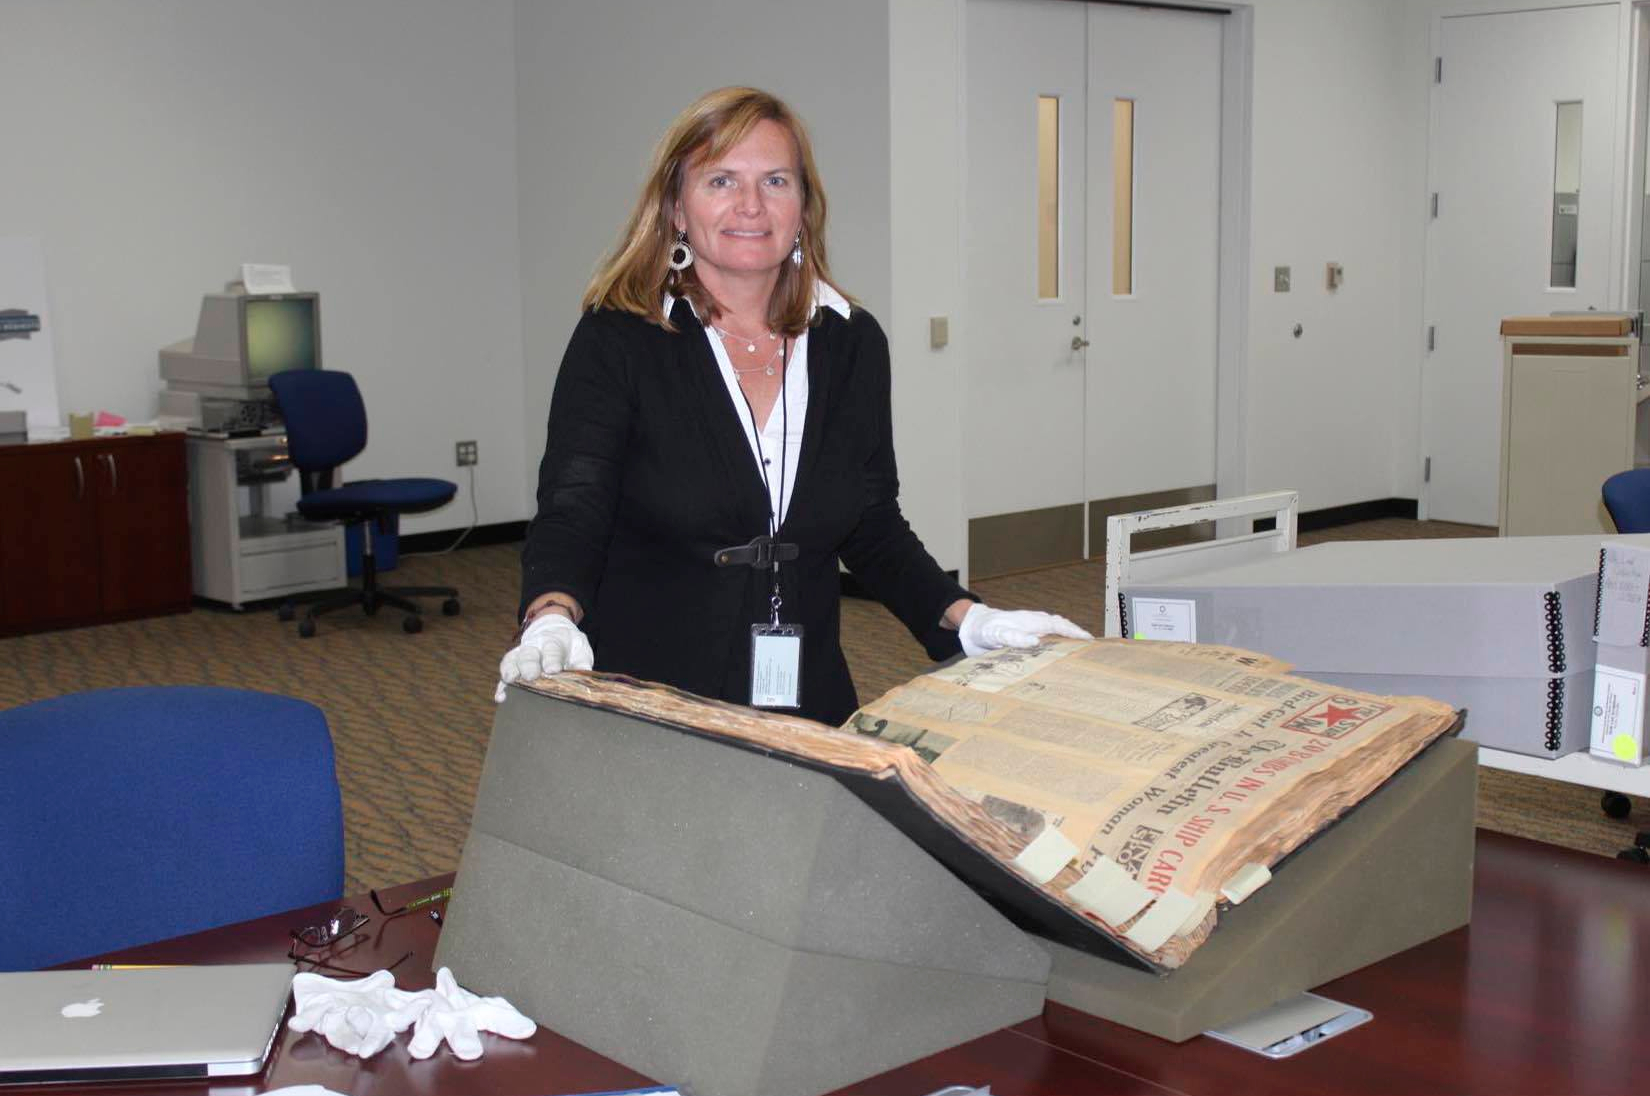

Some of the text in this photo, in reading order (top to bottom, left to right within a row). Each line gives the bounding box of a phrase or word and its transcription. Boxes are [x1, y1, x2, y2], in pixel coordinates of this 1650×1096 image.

[1252, 689, 1320, 729] Bird-Girl
[1165, 741, 1232, 779] Greatest
[1157, 754, 1252, 815] Bulletin
[1235, 776, 1265, 791] IN
[1101, 786, 1166, 836] Woman
[1175, 815, 1216, 848] SHIP
